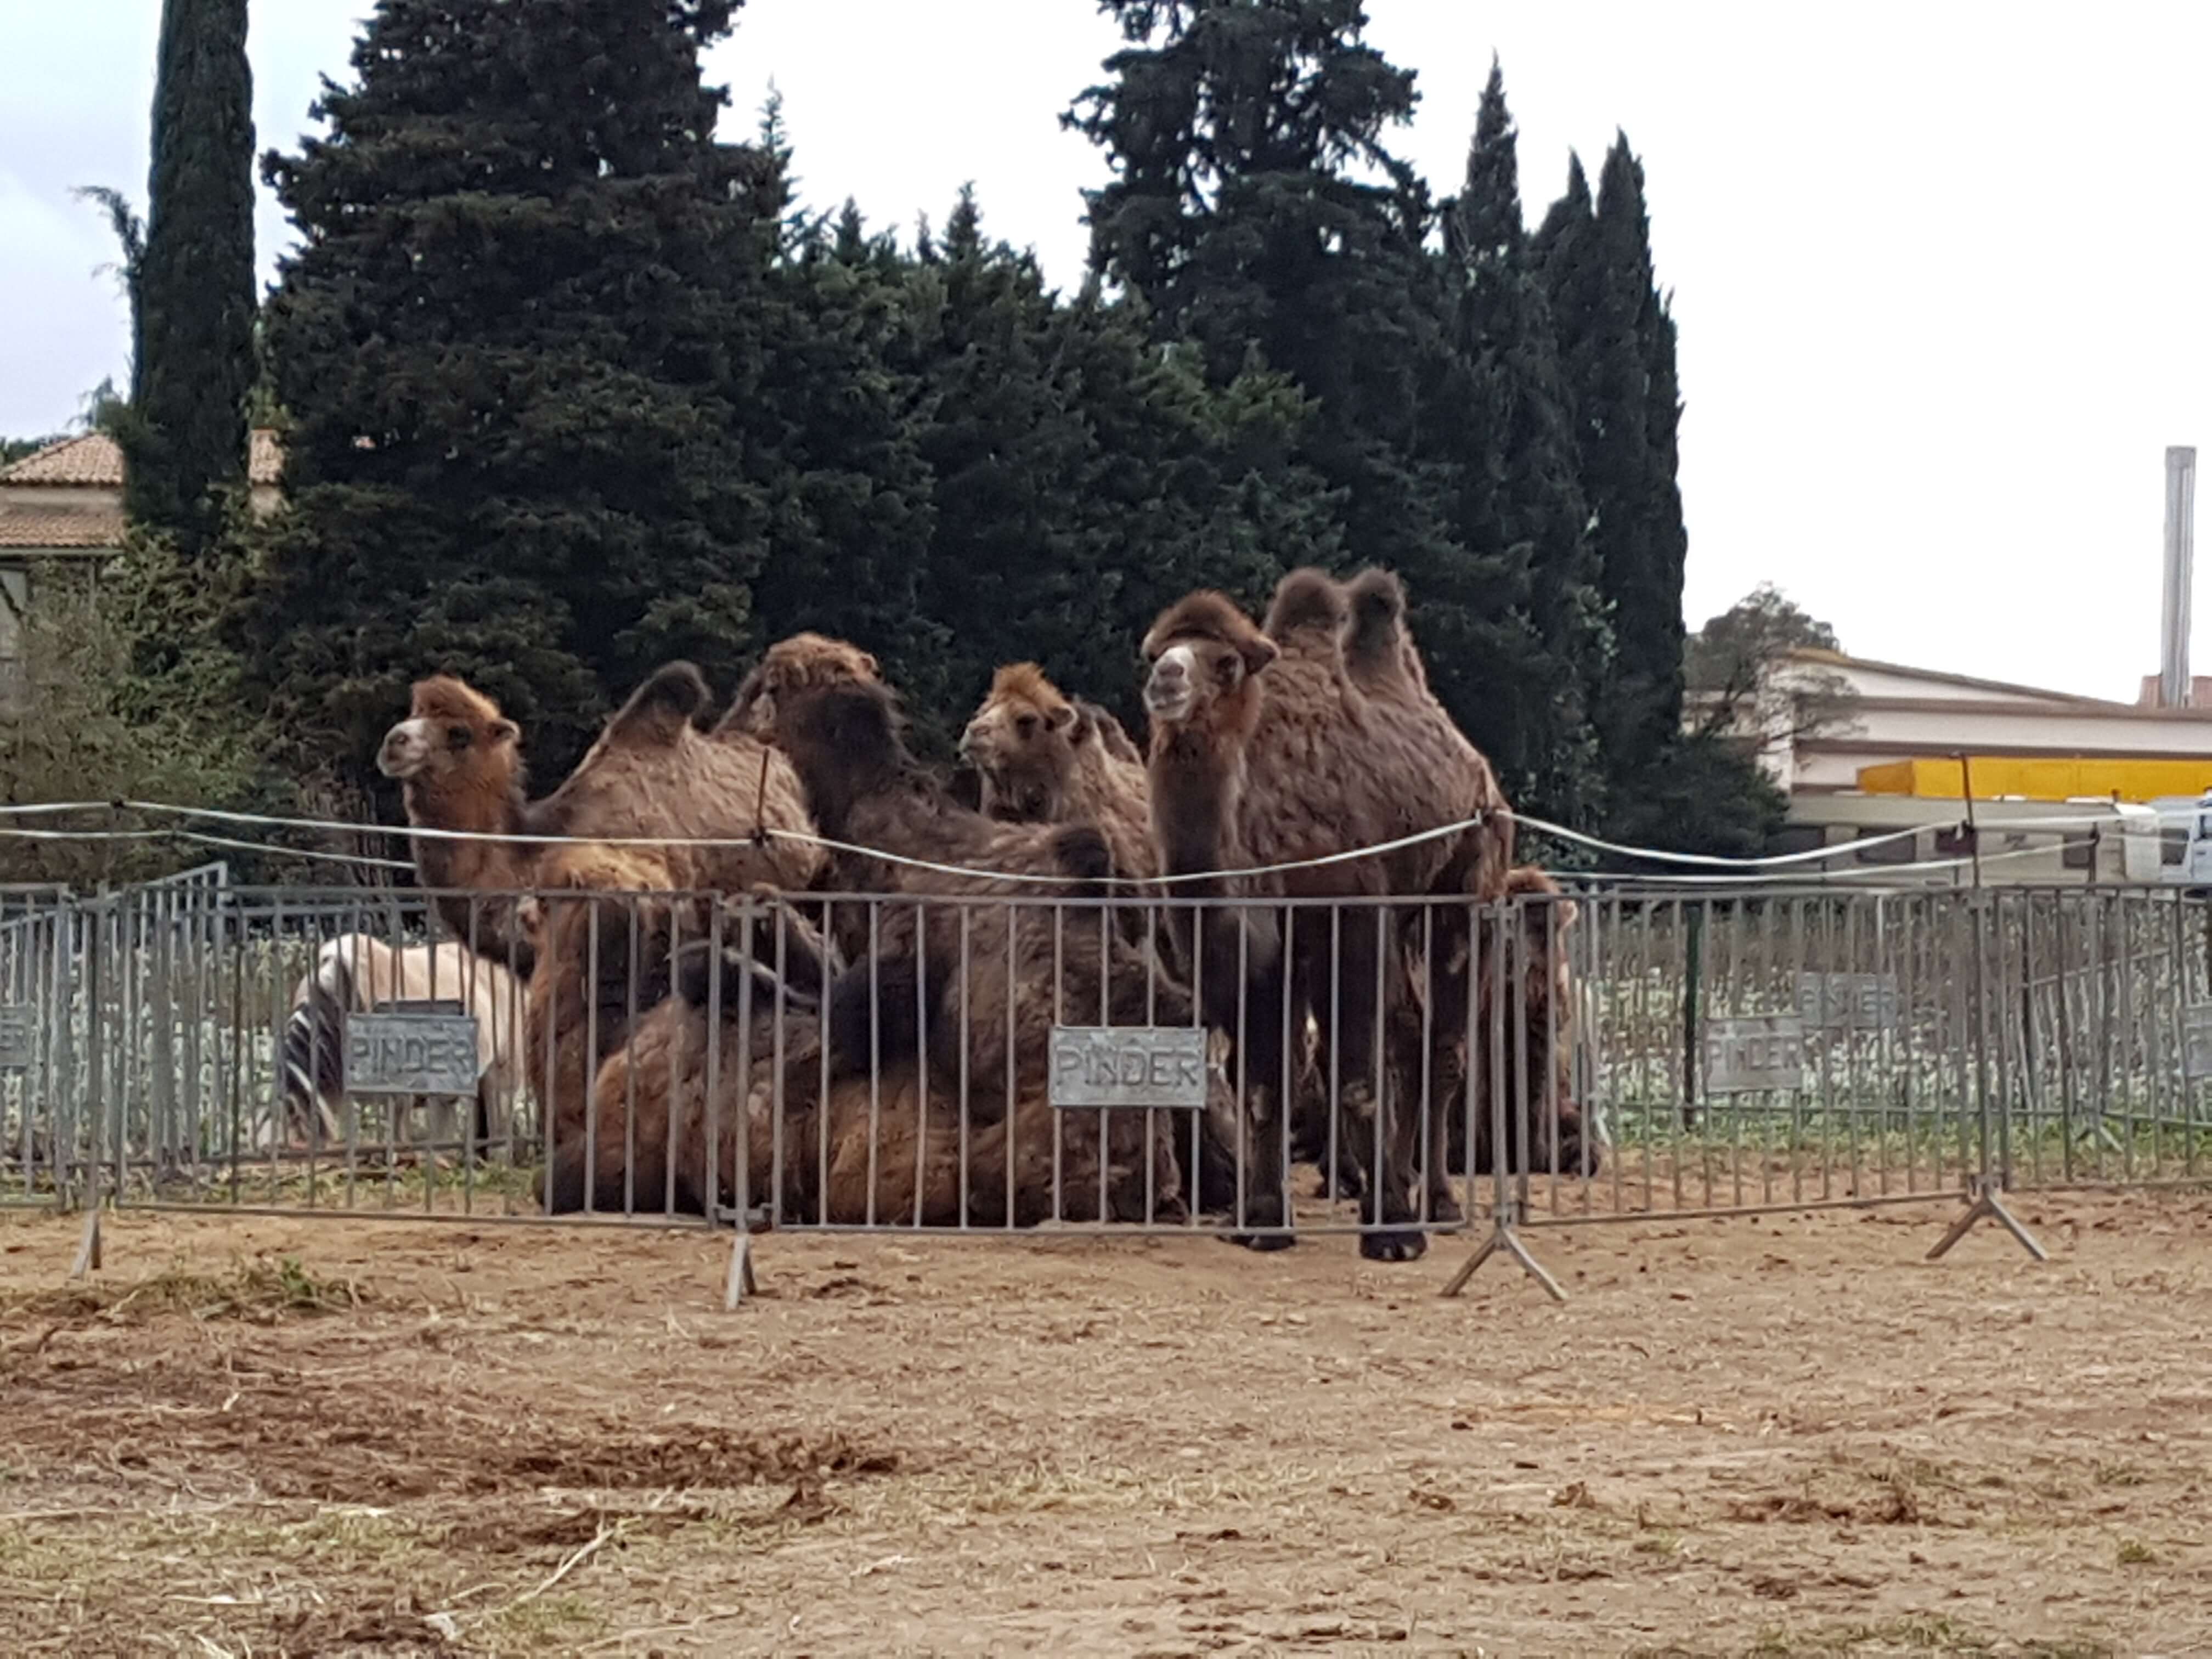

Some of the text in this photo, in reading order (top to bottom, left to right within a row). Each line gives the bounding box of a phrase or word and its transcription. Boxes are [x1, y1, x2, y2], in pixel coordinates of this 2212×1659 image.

[1799, 985, 1895, 1013] PNER
[349, 1035, 472, 1074] PINDER
[1056, 1046, 1201, 1087] PINDER
